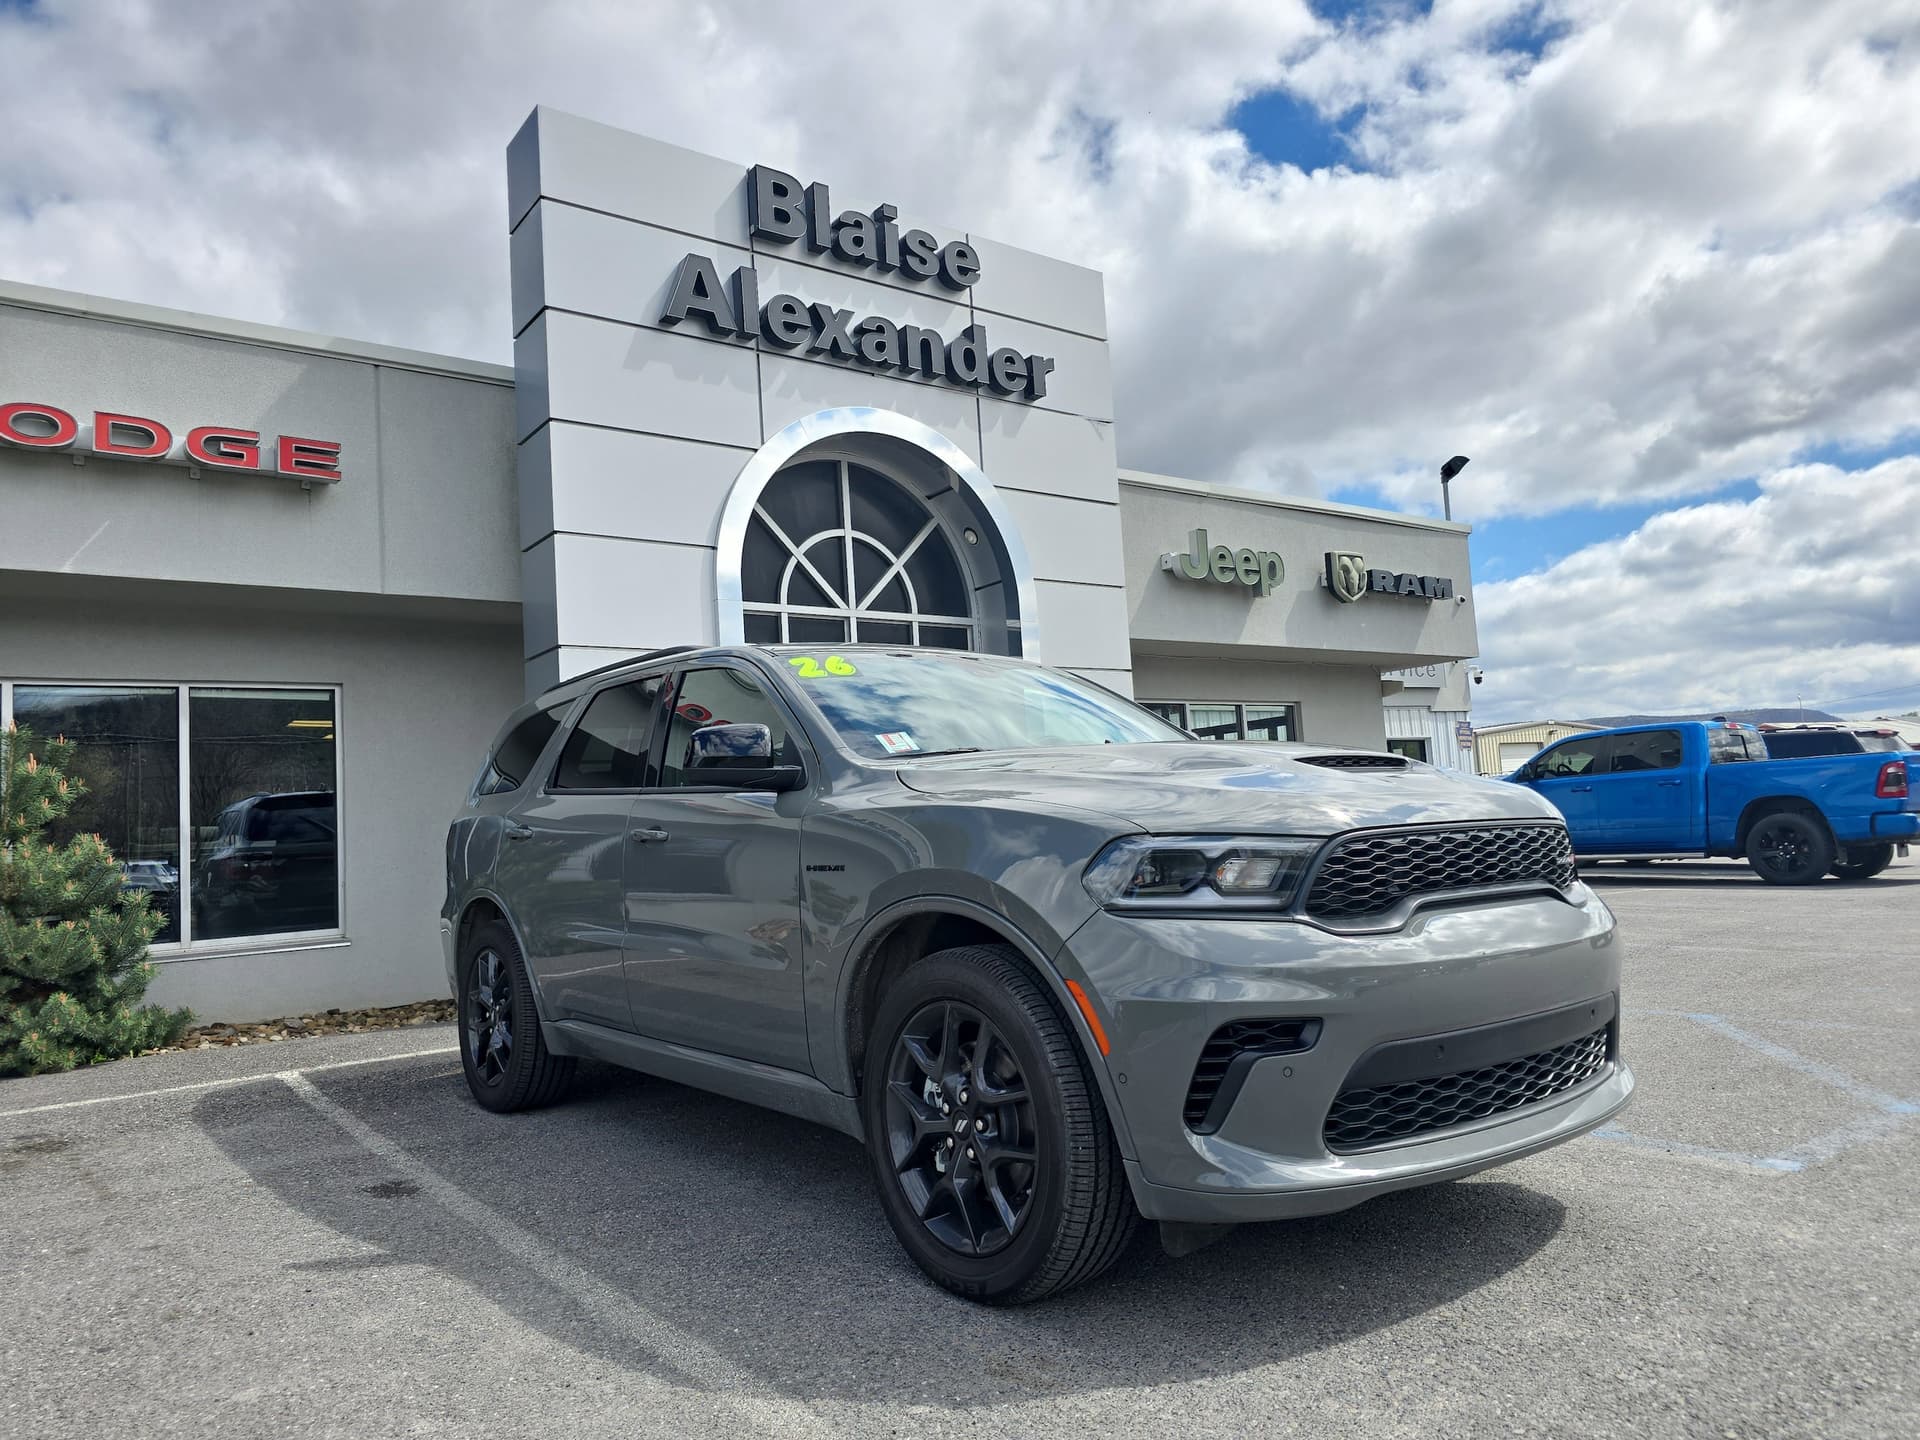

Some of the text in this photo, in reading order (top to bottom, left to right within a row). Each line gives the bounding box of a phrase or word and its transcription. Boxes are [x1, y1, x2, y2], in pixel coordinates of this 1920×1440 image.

[748, 164, 981, 291] Blaise
[658, 252, 1055, 401] Alexander
[1176, 528, 1285, 597] Jeep
[1366, 568, 1453, 600] RAM
[788, 655, 857, 678] 26
